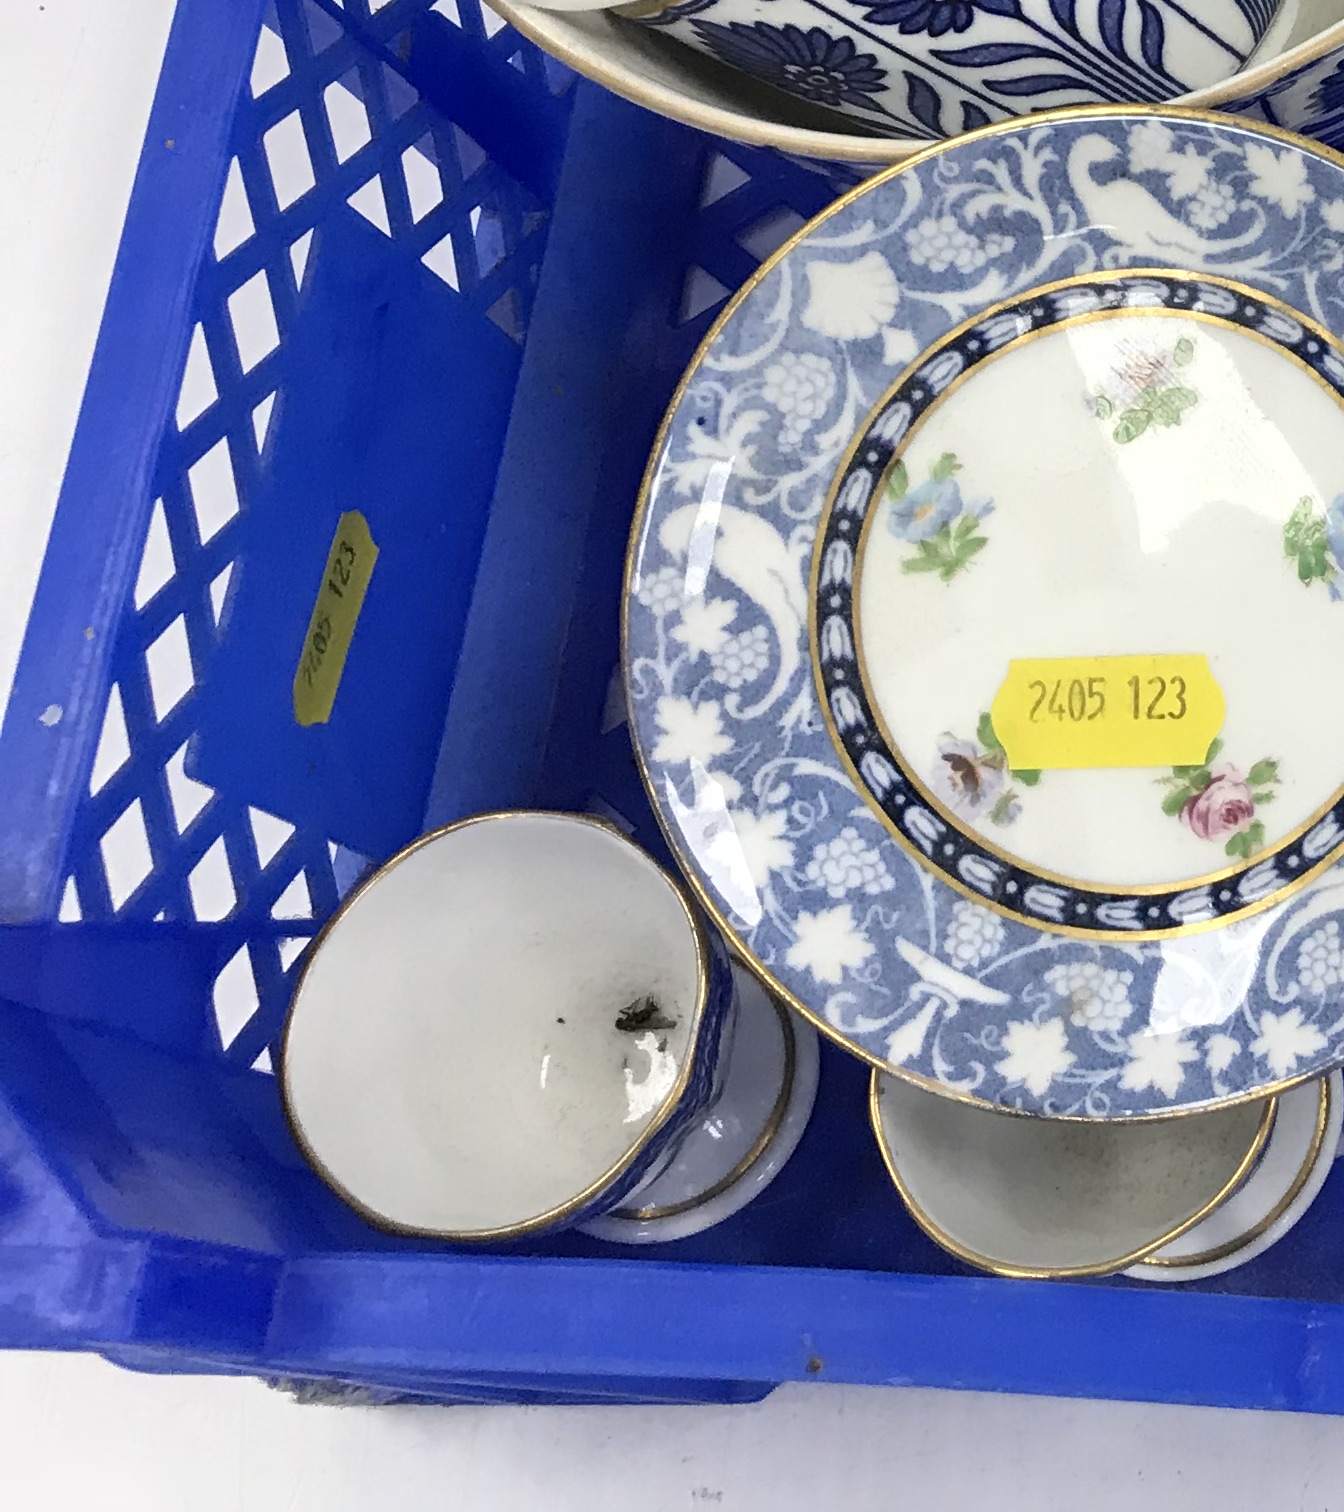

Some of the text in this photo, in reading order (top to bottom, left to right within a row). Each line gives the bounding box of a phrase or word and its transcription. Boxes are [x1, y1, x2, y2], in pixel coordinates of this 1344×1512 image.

[328, 540, 356, 598] 123
[1028, 675, 1188, 724] 2405 123
